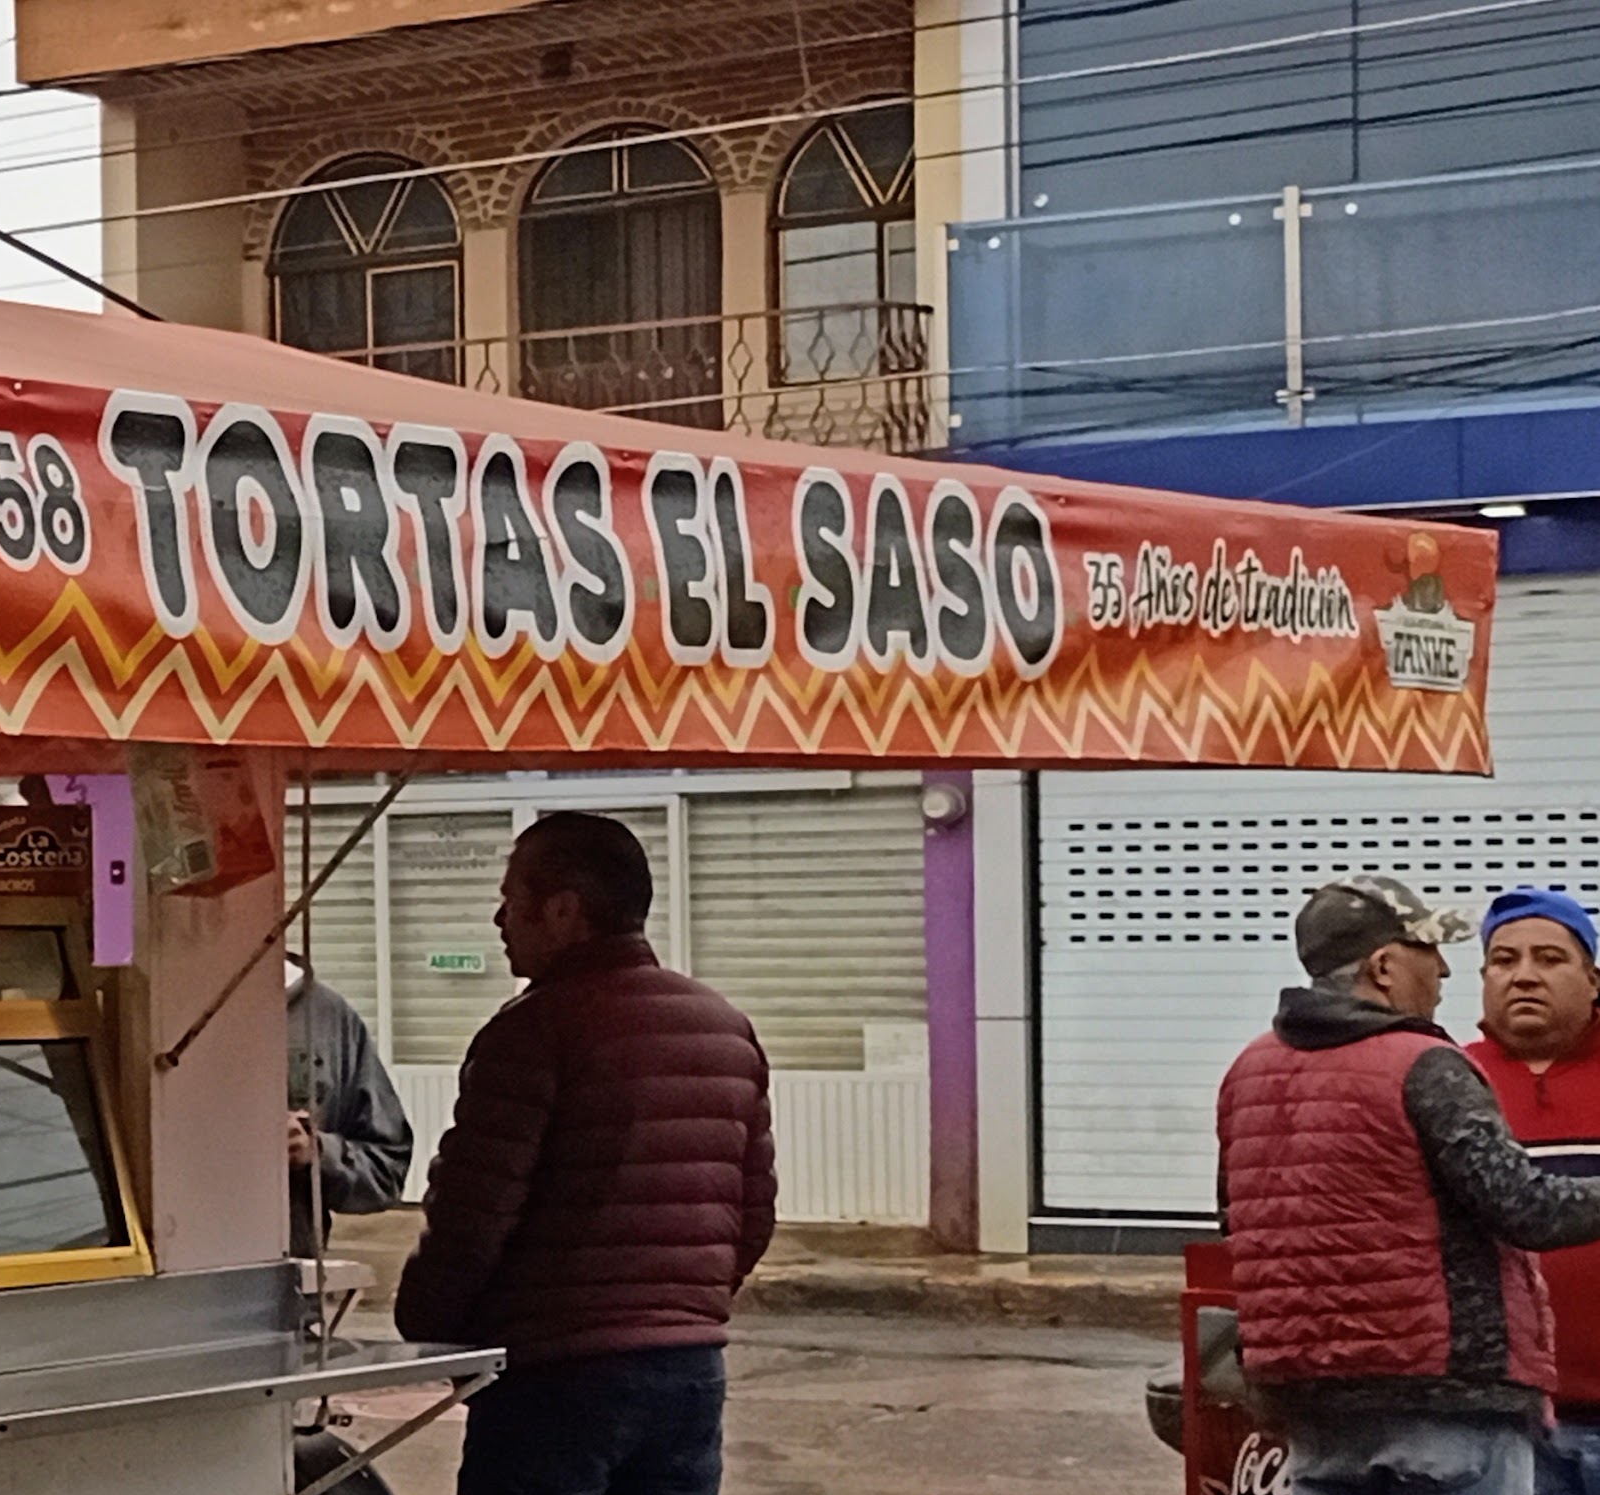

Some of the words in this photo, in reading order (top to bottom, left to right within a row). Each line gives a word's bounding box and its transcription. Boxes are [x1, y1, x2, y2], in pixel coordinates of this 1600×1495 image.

[110, 409, 627, 648] TORTAS
[651, 466, 767, 650] EL
[802, 479, 1055, 667] SASO
[1132, 548, 1194, 628] Años
[1203, 546, 1237, 629] de
[1238, 554, 1355, 636] tradición
[27, 834, 49, 849] La
